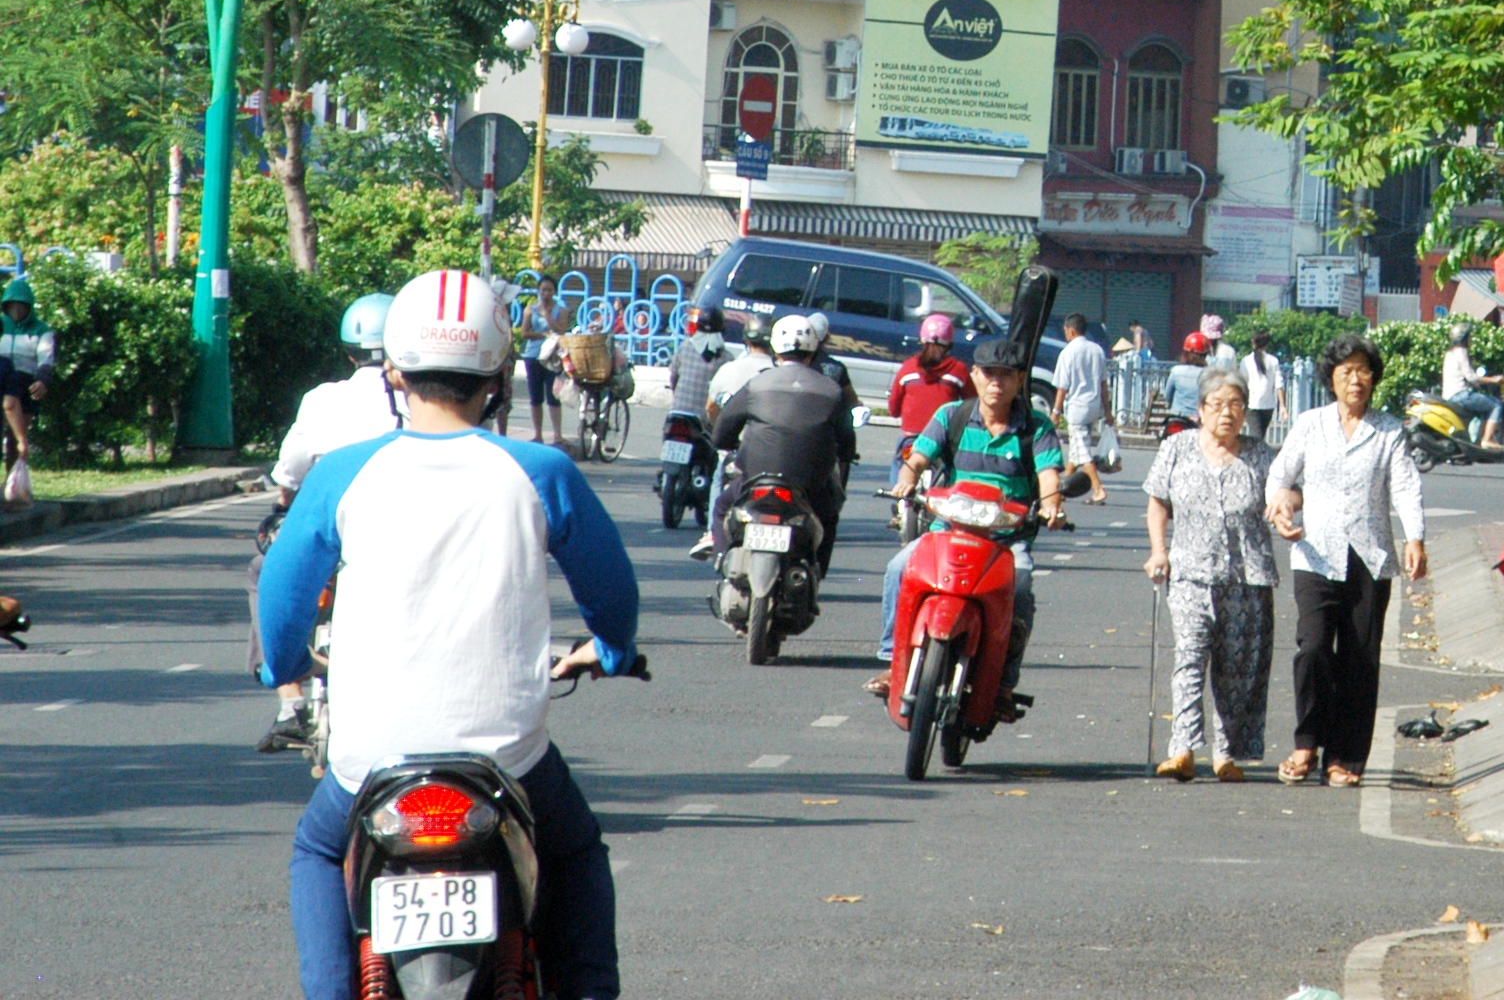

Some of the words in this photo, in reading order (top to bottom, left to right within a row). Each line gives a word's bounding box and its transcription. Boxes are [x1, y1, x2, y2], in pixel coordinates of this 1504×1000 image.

[881, 62, 898, 70] MUA
[929, 64, 935, 73] Ô
[936, 65, 946, 74] TÔ
[948, 66, 962, 75] CÁC
[880, 73, 897, 81] CHO
[898, 73, 918, 82] THUÊ
[920, 74, 926, 83] Ô
[927, 75, 938, 84] TÔ
[879, 93, 900, 102] CUNG
[921, 96, 937, 104] LAO
[910, 85, 932, 94] HÀNG
[983, 89, 1009, 99] KHÁCH
[913, 105, 928, 114] CÁC
[930, 107, 950, 115] TOUR
[951, 108, 962, 116] DU
[963, 109, 981, 119] LỊCH
[982, 111, 1008, 120] TRONG
[420, 326, 479, 342] DRAGON
[393, 879, 477, 910] 54-P8
[393, 910, 477, 945] 7703
